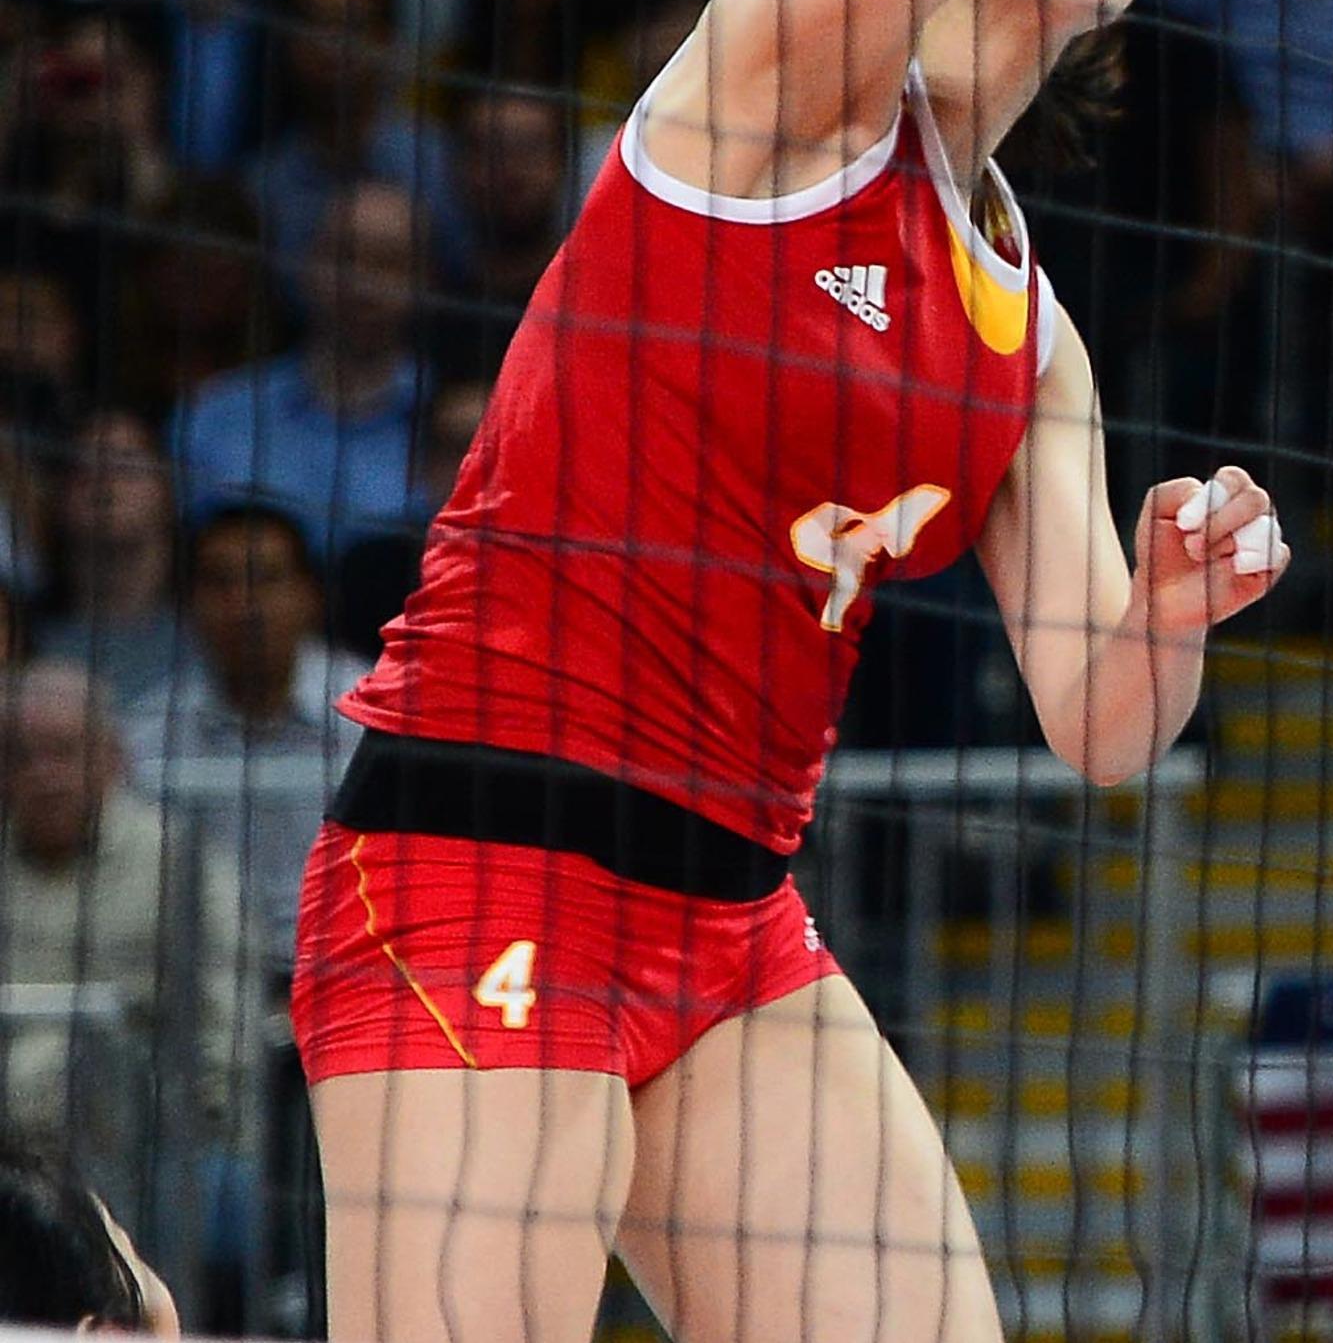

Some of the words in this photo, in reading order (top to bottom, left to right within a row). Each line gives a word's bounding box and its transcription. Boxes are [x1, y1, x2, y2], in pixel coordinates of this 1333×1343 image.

[814, 268, 892, 332] adidas
[789, 483, 952, 633] 4
[471, 939, 538, 1029] 4
